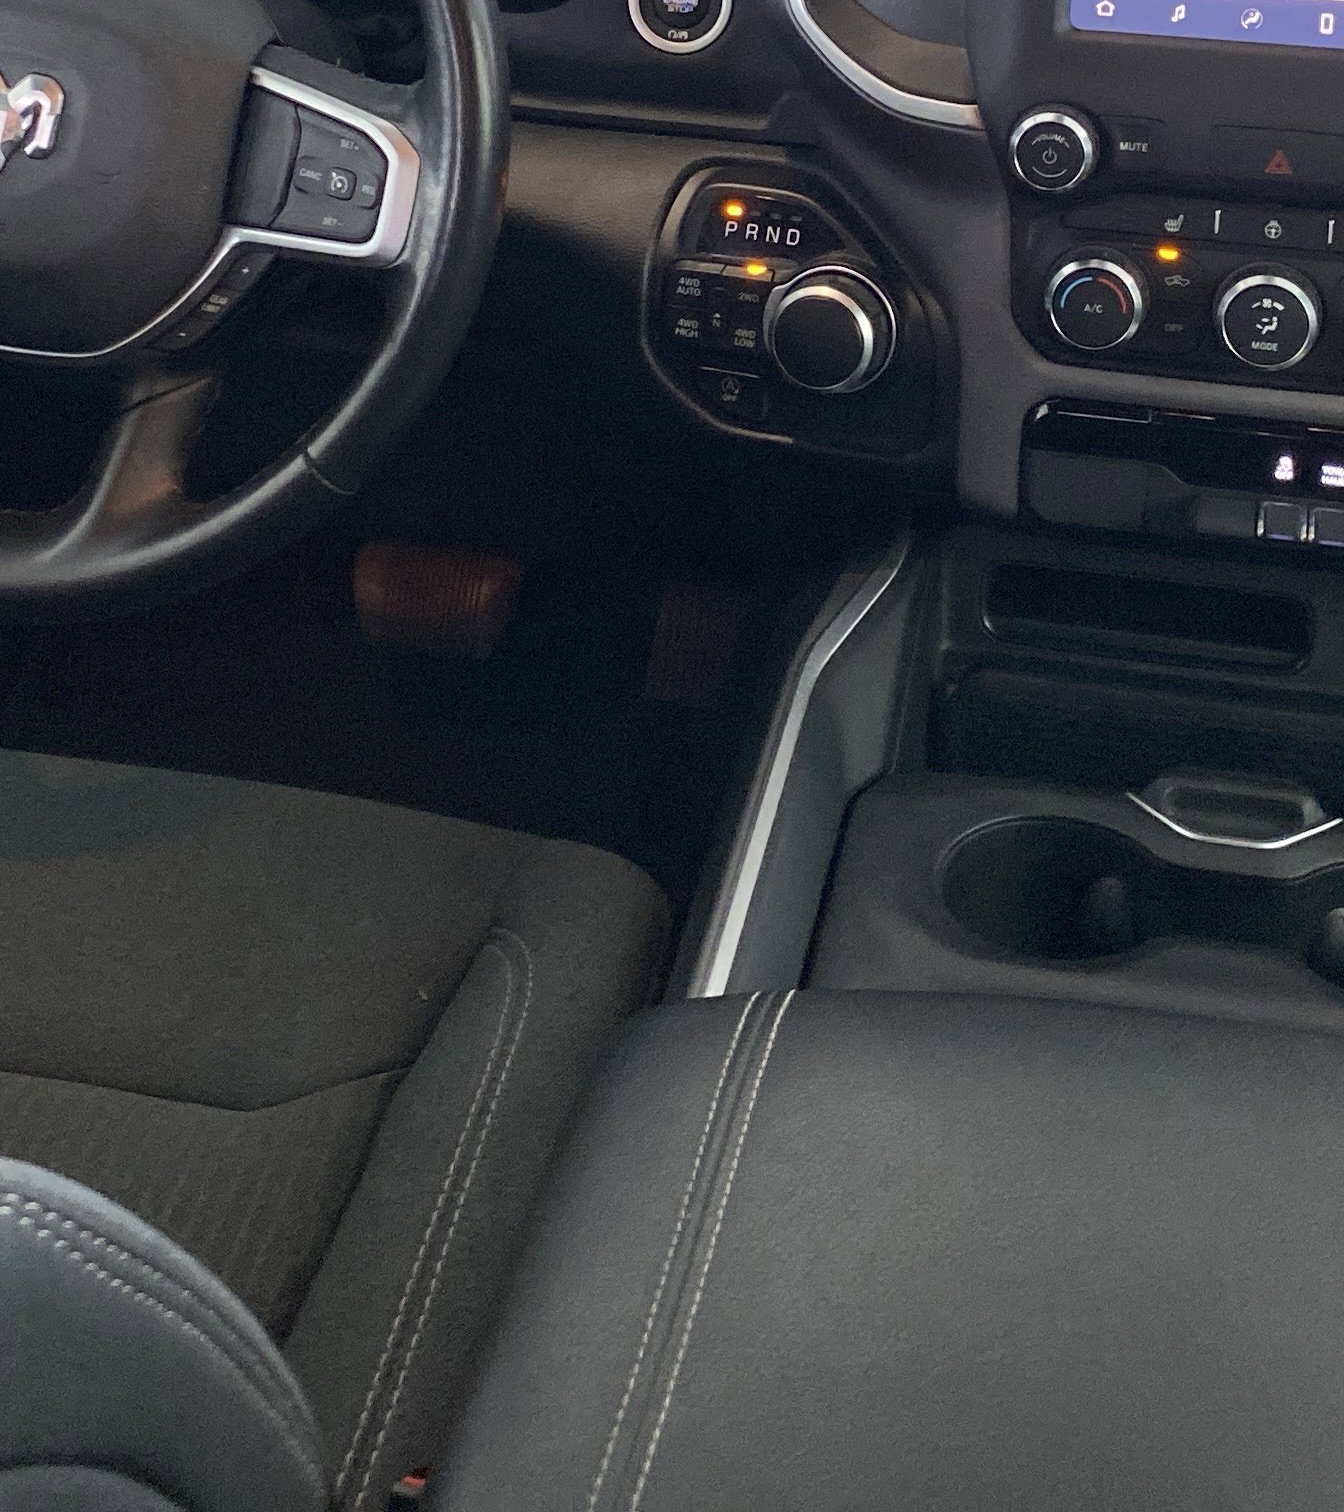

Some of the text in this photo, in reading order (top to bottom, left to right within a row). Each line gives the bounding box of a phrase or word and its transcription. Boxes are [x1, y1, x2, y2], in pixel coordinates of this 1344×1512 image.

[1120, 141, 1148, 153] MUTE
[724, 221, 800, 245] P R N D
[678, 277, 701, 287] 4WD
[676, 285, 701, 297] AUTO
[738, 292, 760, 303] 2WD
[1084, 303, 1103, 314] A/C
[677, 318, 699, 328] 4WD
[674, 326, 698, 337] HIGH
[735, 328, 756, 338] 4WD
[734, 337, 755, 348] LOW
[1251, 341, 1278, 353] MODE
